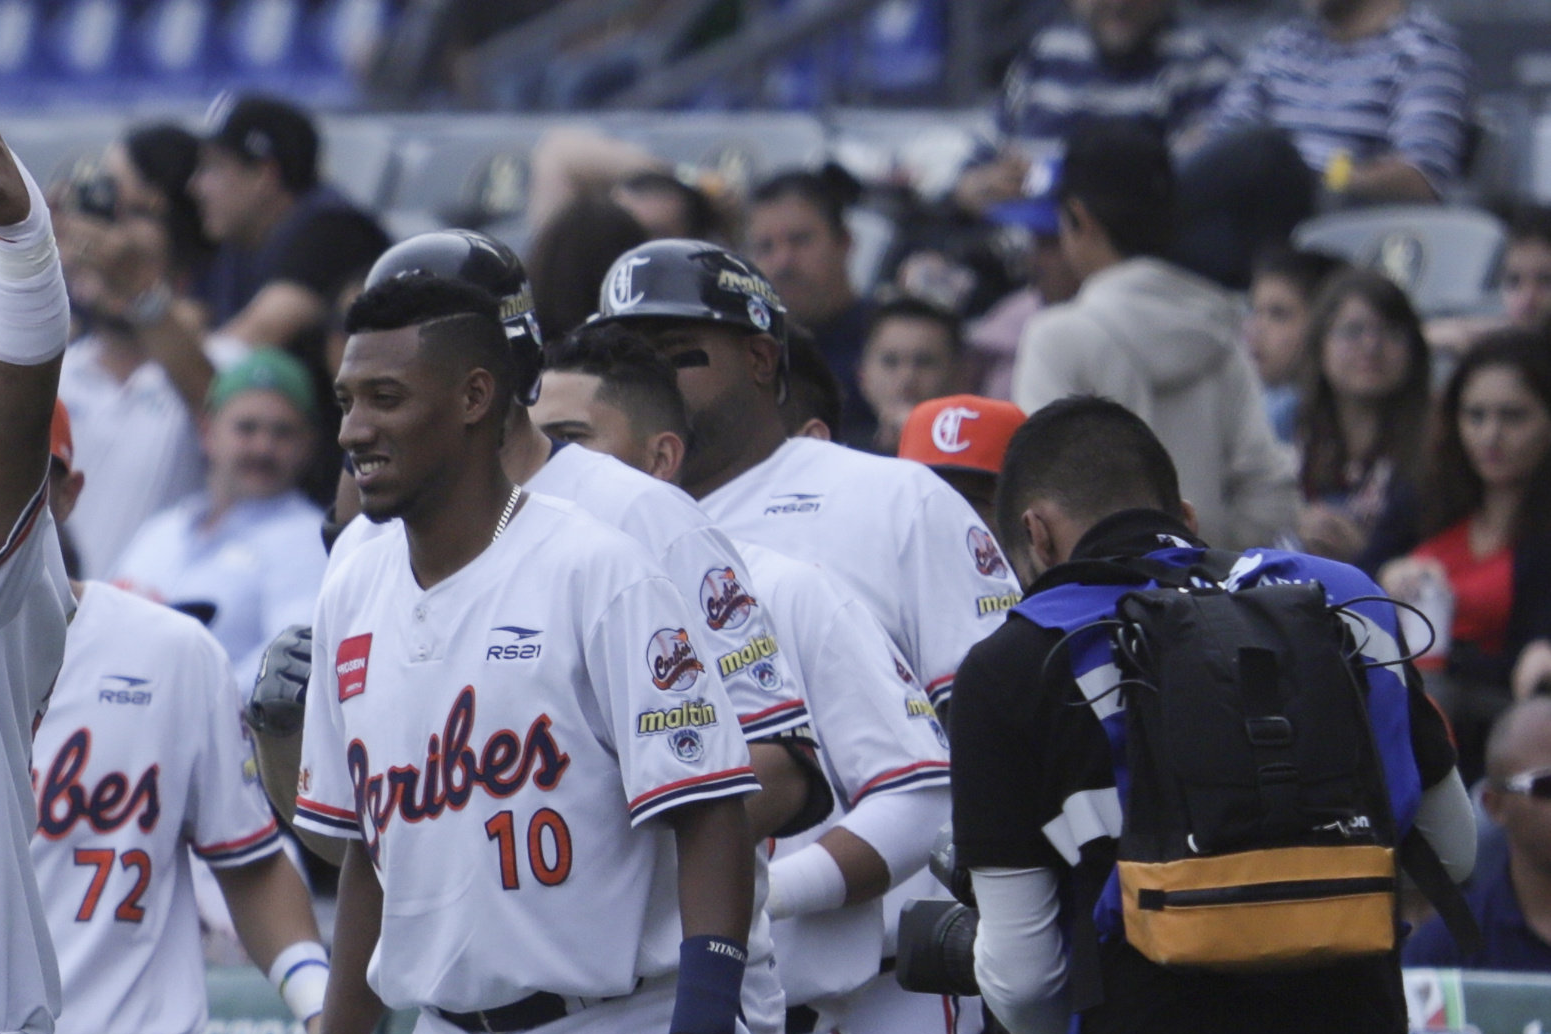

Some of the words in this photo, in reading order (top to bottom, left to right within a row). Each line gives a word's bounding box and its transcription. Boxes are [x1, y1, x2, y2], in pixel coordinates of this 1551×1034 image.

[486, 644, 542, 661] RS21
[99, 688, 152, 706] RS21
[31, 726, 160, 841] bes
[73, 848, 153, 924] 72
[484, 807, 573, 891] 10
